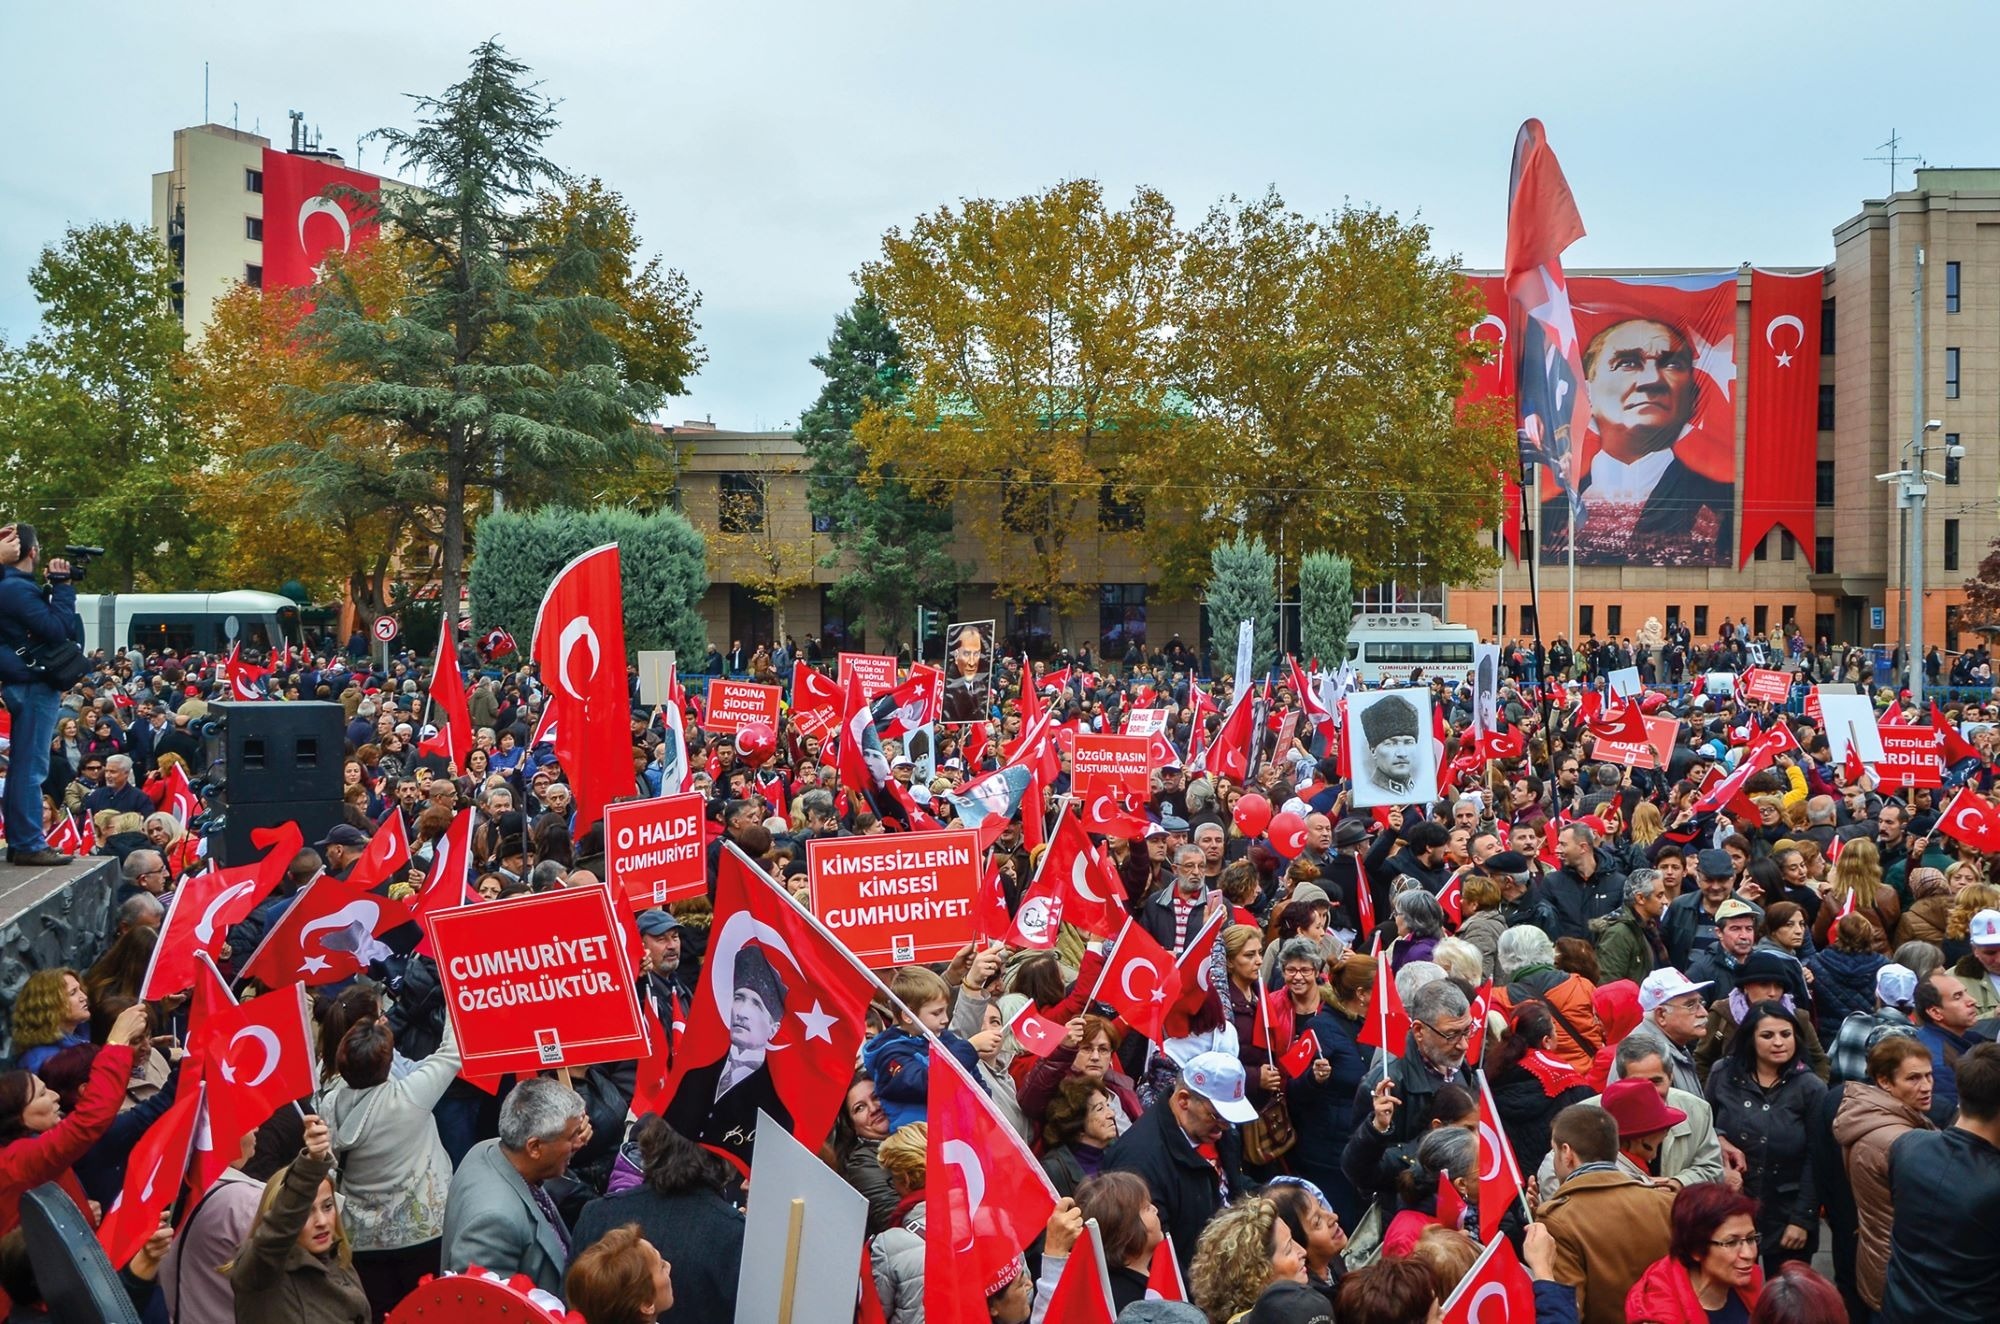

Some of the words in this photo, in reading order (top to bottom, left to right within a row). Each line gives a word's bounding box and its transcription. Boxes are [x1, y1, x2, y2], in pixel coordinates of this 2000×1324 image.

[872, 659, 890, 667] OLMA
[724, 686, 766, 699] KADINA
[723, 698, 765, 711] ŞİDDETİ
[712, 709, 773, 724] KINIYORUZ.
[1884, 736, 1938, 749] İSTEDİLER
[1076, 748, 1113, 761] ÖZGÜR
[1115, 751, 1146, 762] BASIN
[1075, 763, 1147, 774] SUSTURULAMAZ!
[617, 827, 634, 850] O
[638, 815, 697, 847] HALDE
[615, 842, 700, 874] CUMHURİYET
[822, 845, 970, 876] KİMSESİZLERİN
[858, 871, 938, 898] KİMSESİ
[825, 896, 973, 929] CUMHURİYET.
[450, 935, 608, 981] CUMHURİYET
[458, 967, 621, 1012] ÖZGÜRLÜKTÜR.
[543, 1044, 556, 1053] CHP
[997, 1263, 1012, 1278] NE
